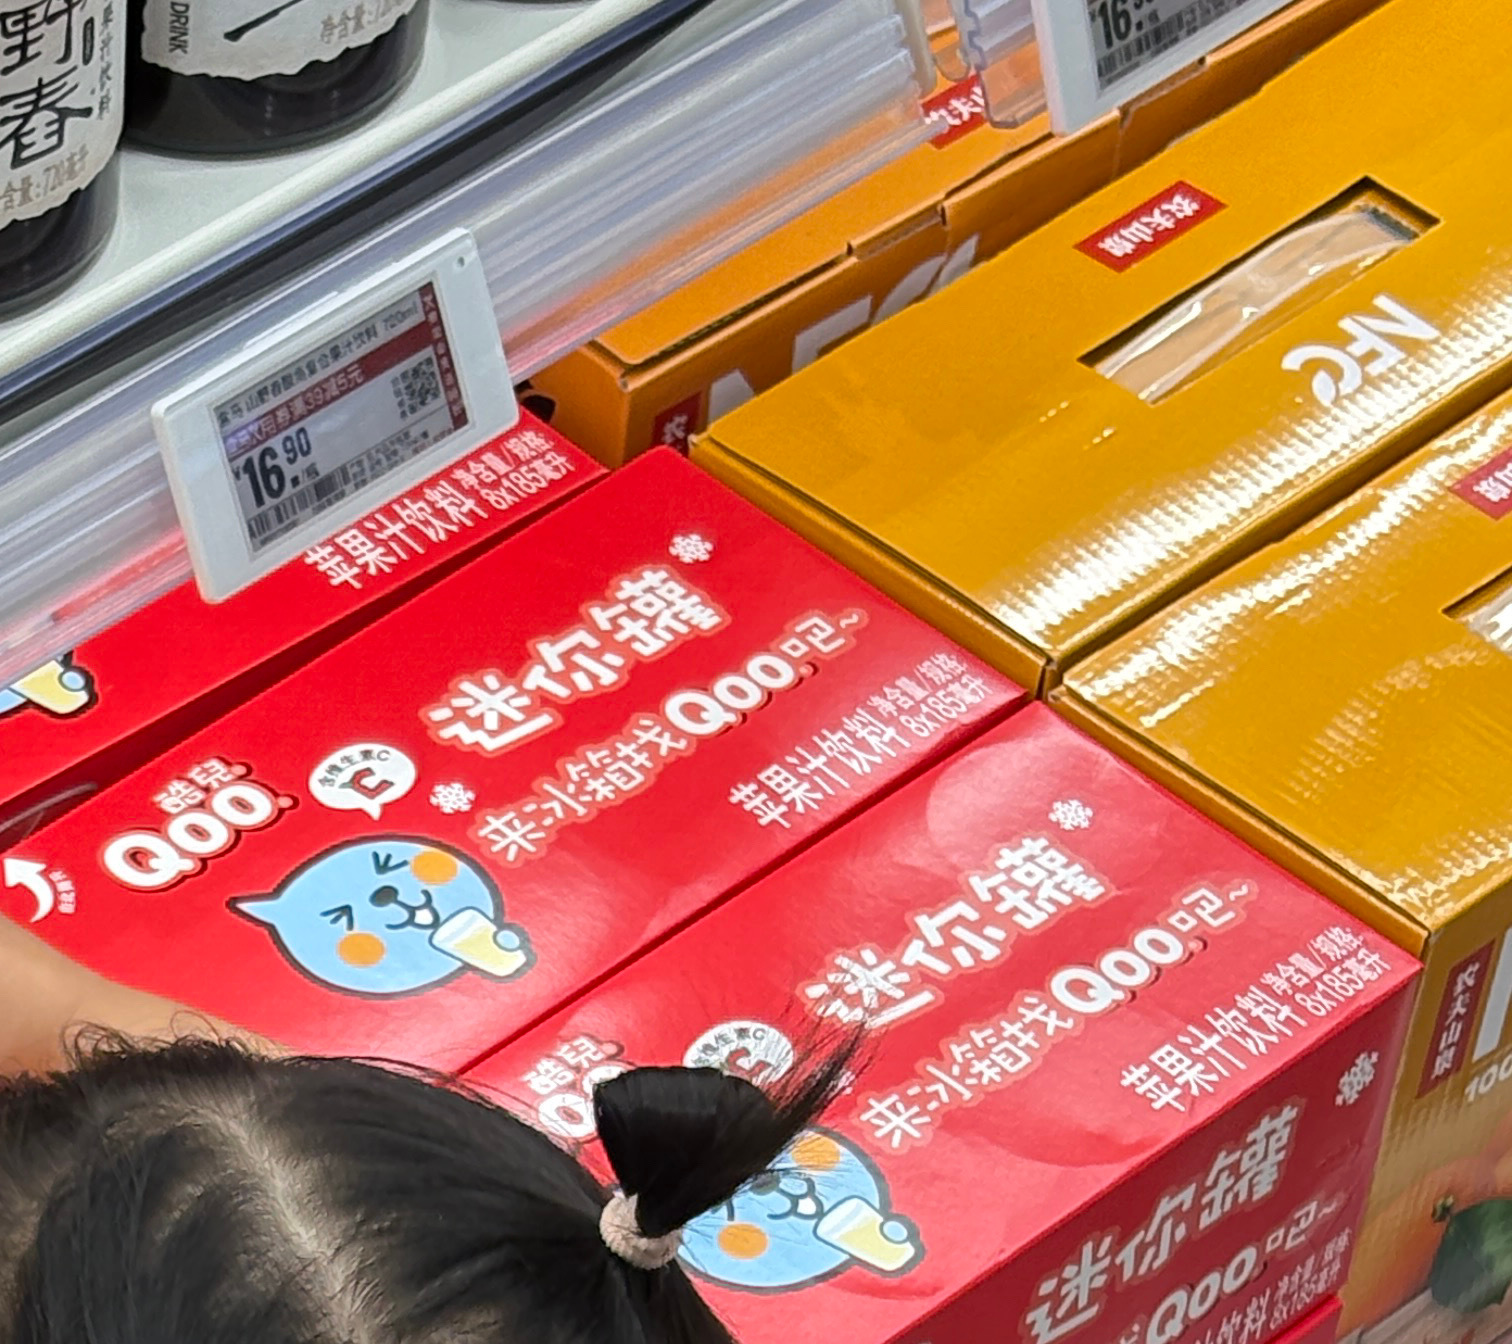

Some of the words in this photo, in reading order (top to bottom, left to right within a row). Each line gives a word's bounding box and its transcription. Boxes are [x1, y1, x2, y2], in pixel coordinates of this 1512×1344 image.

[169, 1, 190, 54] DRINK
[1098, 195, 1201, 257] 农夫山泉
[1282, 294, 1439, 405] NFC
[302, 481, 488, 591] 苹果汁饮料
[430, 569, 726, 753] 迷你罐
[728, 705, 911, 830] 苹果汁饮料
[805, 837, 1106, 1028] 迷你罐
[1120, 995, 1308, 1113] 苹果汁饮料
